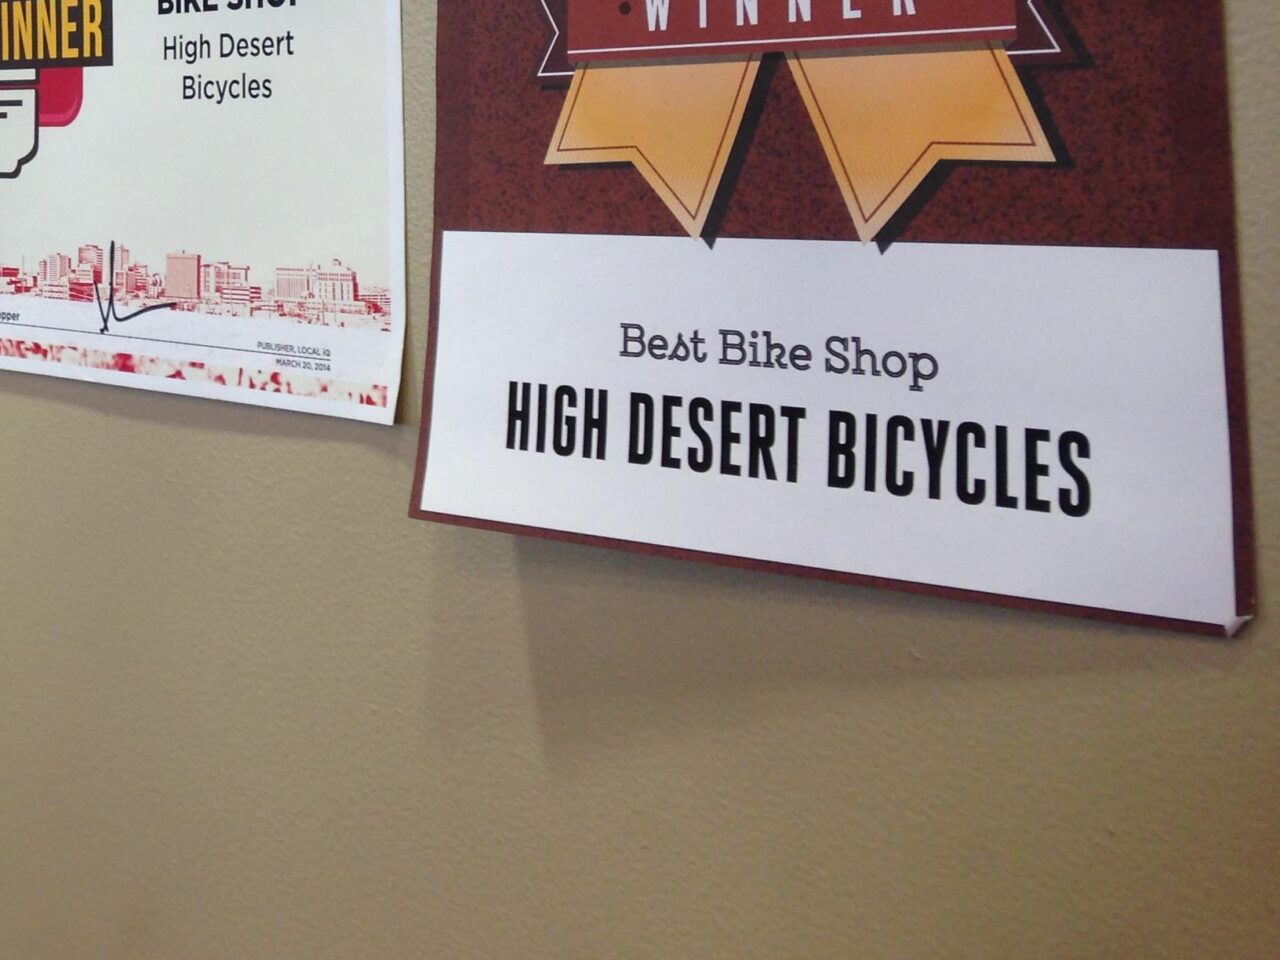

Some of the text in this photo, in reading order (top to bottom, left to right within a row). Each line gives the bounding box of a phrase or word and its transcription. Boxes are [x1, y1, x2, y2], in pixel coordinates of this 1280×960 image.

[163, 30, 294, 65] High Desert
[182, 72, 273, 105] Bicycles
[257, 341, 297, 354] PUBLISHER,
[297, 346, 321, 356] LOCAL
[275, 358, 301, 368] MARCH
[314, 362, 331, 372] 2014
[619, 322, 940, 392] Best Bike Shop
[505, 380, 1092, 519] HIGH DESERT BICYCLES
